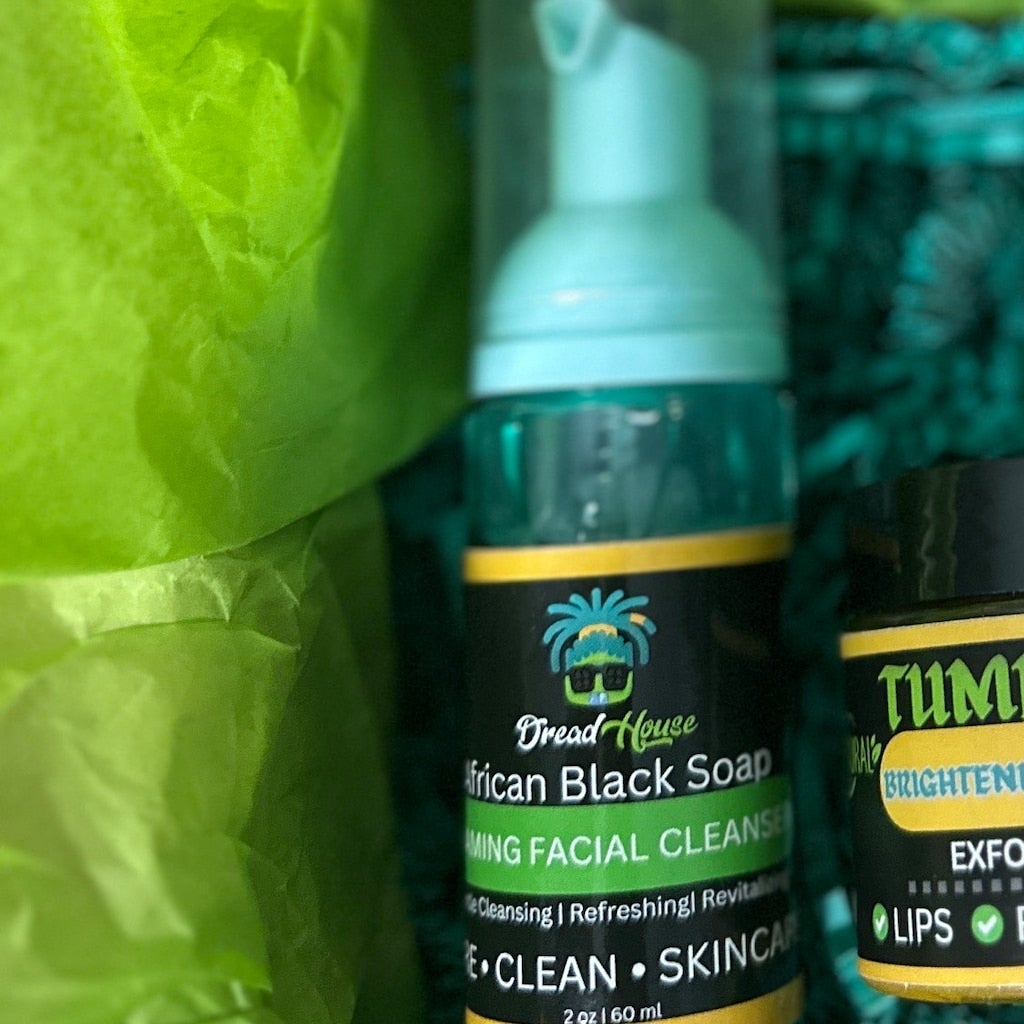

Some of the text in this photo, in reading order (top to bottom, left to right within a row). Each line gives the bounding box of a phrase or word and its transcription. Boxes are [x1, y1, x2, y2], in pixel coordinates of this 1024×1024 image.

[514, 709, 699, 752] Dread House
[561, 757, 676, 803] Black
[687, 747, 772, 789] Soap
[530, 832, 649, 867] FACIAL
[659, 802, 792, 858] CLEANSE
[478, 896, 553, 928] Cleansing
[893, 906, 954, 945] LIPS
[495, 952, 617, 993] CLEAN
[563, 1008, 575, 1024] 2
[611, 1005, 635, 1022] 60
[640, 1001, 663, 1021] ml
